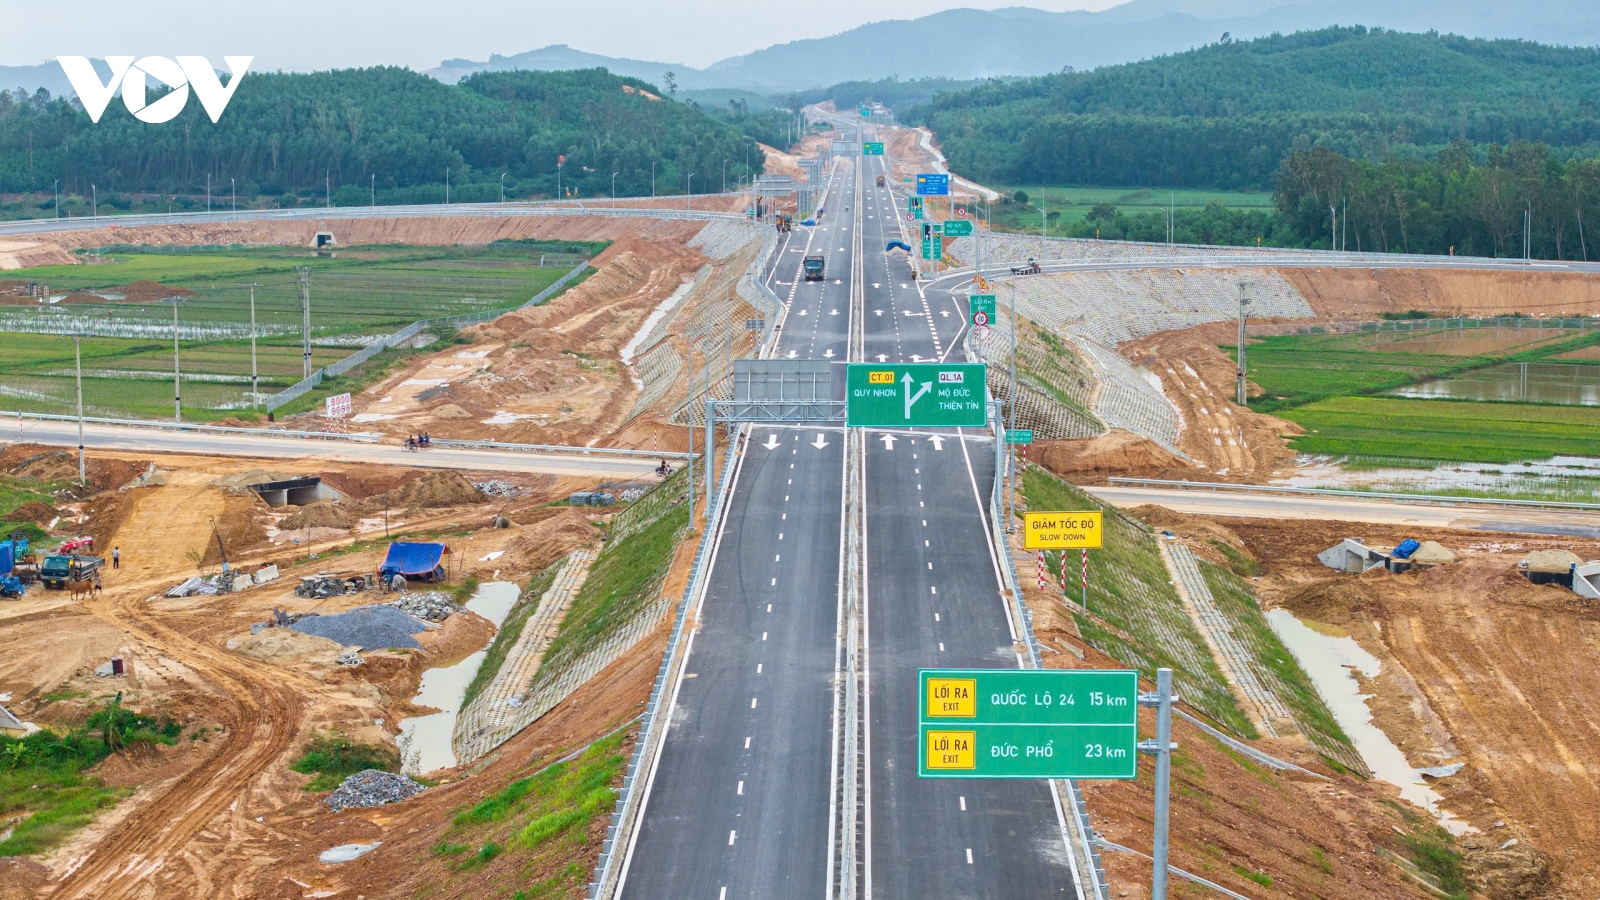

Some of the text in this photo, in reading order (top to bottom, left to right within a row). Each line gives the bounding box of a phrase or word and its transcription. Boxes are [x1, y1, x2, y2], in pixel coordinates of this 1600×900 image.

[871, 373, 893, 382] CT.01
[940, 373, 962, 382] QL.1A
[854, 388, 897, 398] QUY NHƠN
[938, 386, 971, 399] MỘ ĐỨC
[938, 400, 979, 412] THIỆN TÍN
[1032, 516, 1094, 531] GIẢM TỐC ĐỘ
[1039, 533, 1086, 541] SLOW DOWN
[934, 683, 968, 699] LỐI RA
[991, 688, 1127, 709] QUỐC LỘ 24 15 km
[943, 702, 959, 712] EXIT
[934, 735, 968, 751] LỐI RA
[991, 739, 1126, 758] ĐỨC PHỔ 23 km
[943, 754, 959, 764] EXIT
